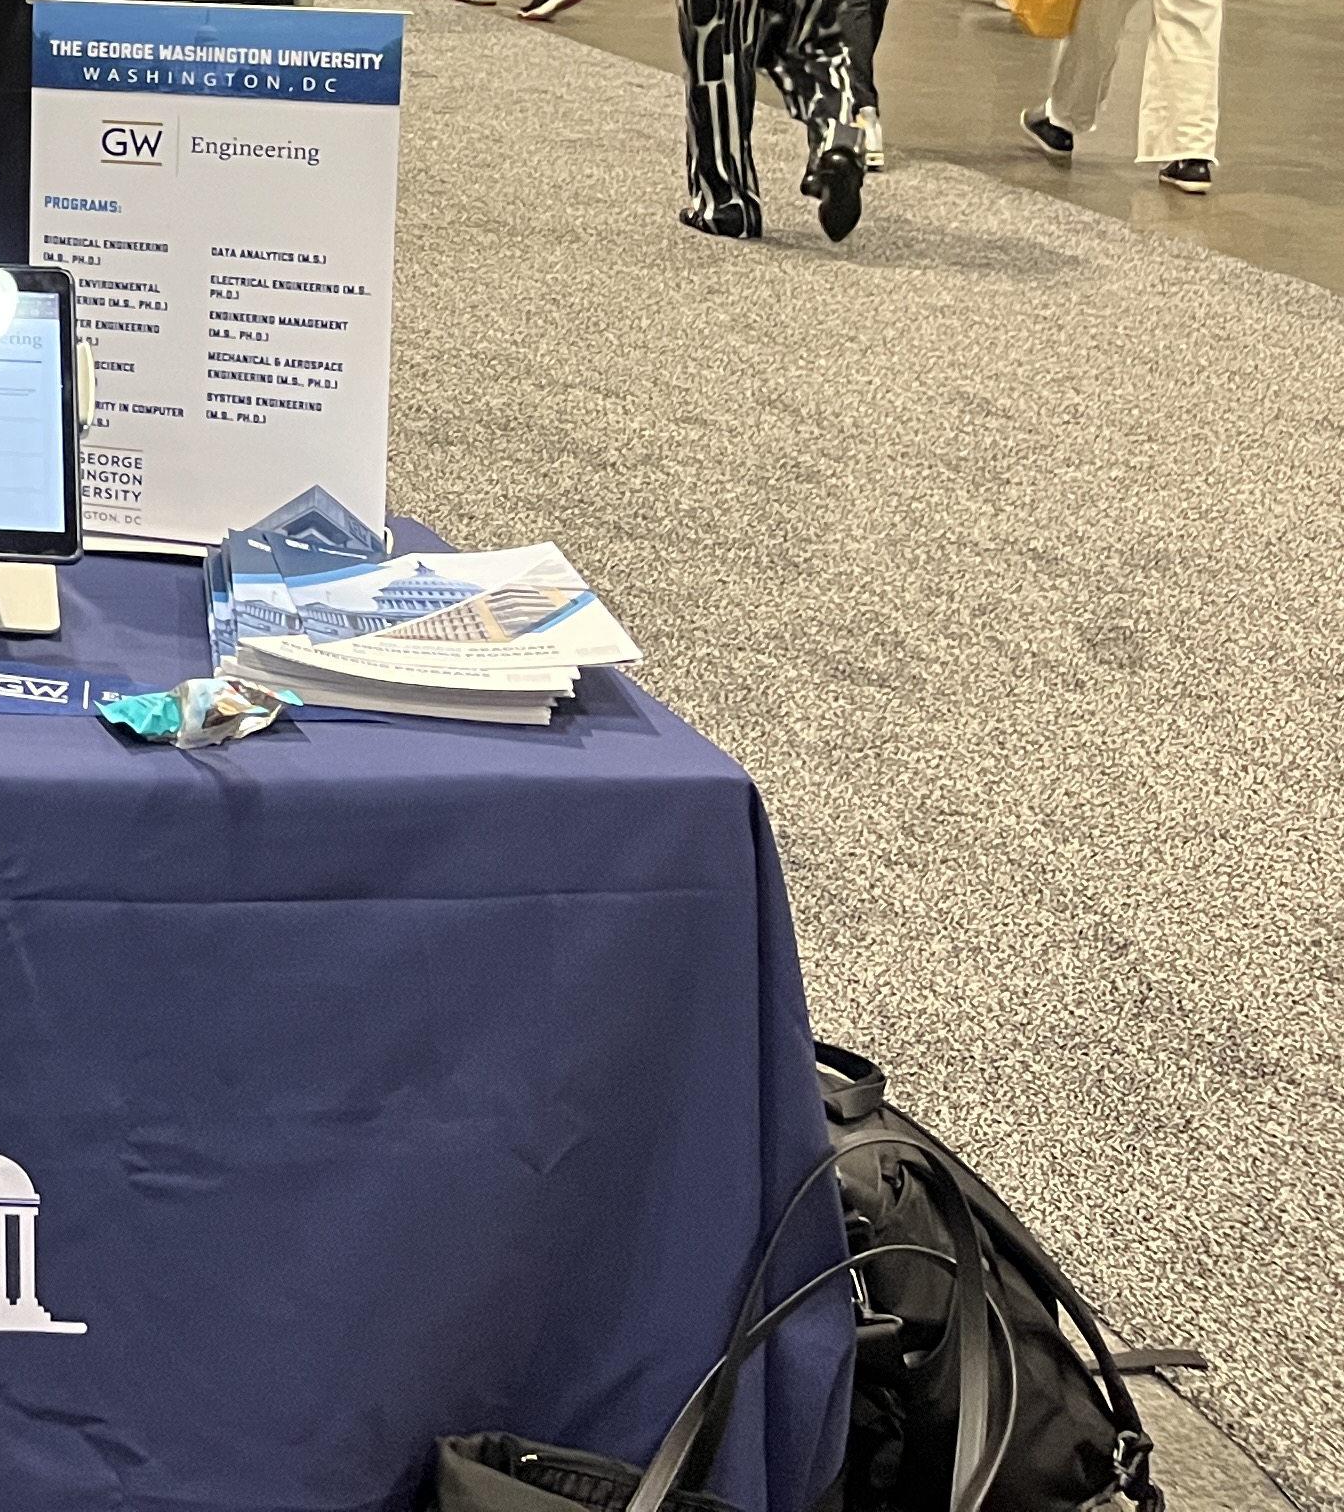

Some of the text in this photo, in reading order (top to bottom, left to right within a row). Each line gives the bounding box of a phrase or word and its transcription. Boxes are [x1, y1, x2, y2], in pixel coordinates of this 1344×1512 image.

[50, 39, 384, 71] THE GEORGE WASHINGTON UNIVERSITY
[101, 127, 320, 166] GW Engineering
[43, 194, 122, 214] PROGRAMS:
[43, 234, 169, 253] BIOMEDICAL ENGINEERING
[211, 246, 237, 258] DATA
[239, 249, 295, 263] ANALYTICS
[78, 278, 161, 294] ENVIRONMENTAL
[210, 274, 270, 289] ELECTRICAL
[272, 279, 340, 294] ENGINEERING
[95, 319, 160, 334] ENGINEERING
[209, 310, 349, 332] ENGINEERING MANAGEMENT
[208, 351, 272, 366] MECHANICAL
[283, 358, 344, 373] AEROSPACE
[207, 369, 274, 384] ENGINEERING
[118, 402, 130, 413] IN
[131, 403, 185, 418] COMPUTER
[206, 392, 323, 412] SYSTEMS ENGINEERING
[81, 468, 143, 486] INGTON
[82, 485, 142, 503] ERSITY
[124, 514, 142, 526] DC
